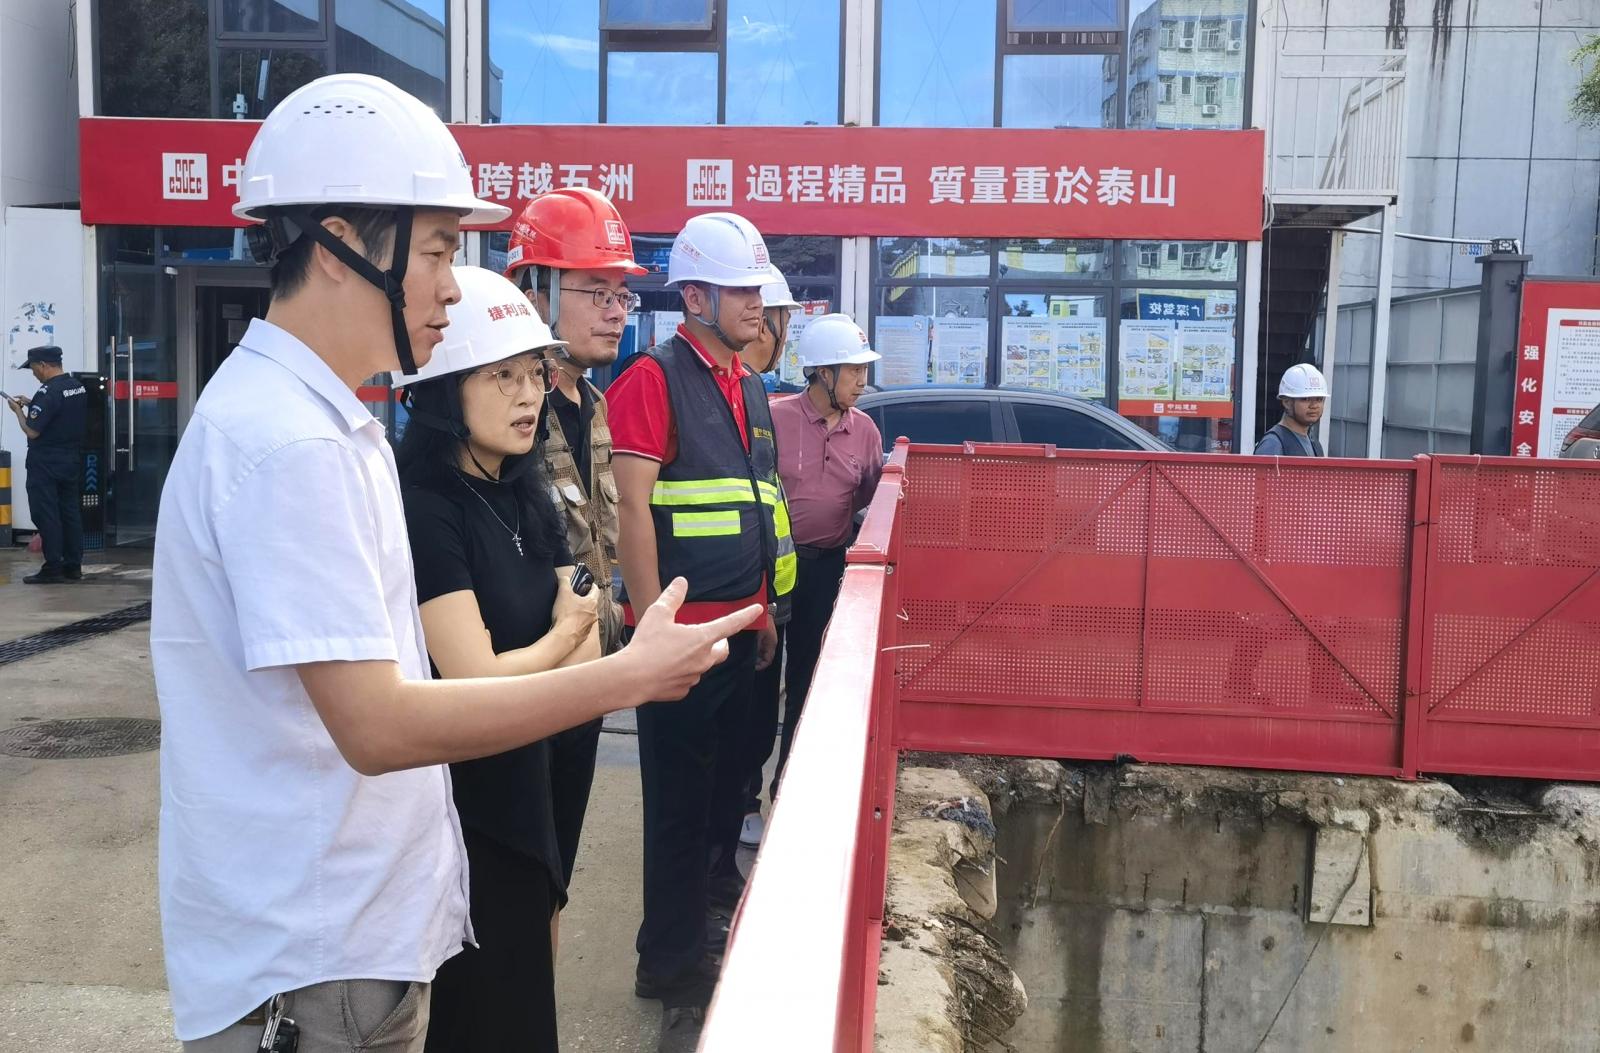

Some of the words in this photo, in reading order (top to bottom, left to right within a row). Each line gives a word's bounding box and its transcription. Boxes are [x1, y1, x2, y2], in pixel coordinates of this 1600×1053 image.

[469, 162, 633, 204] 跨越五洲
[746, 165, 906, 204] 過程精品
[929, 166, 1177, 207] 質量重於泰山
[487, 302, 531, 321] 捷利成
